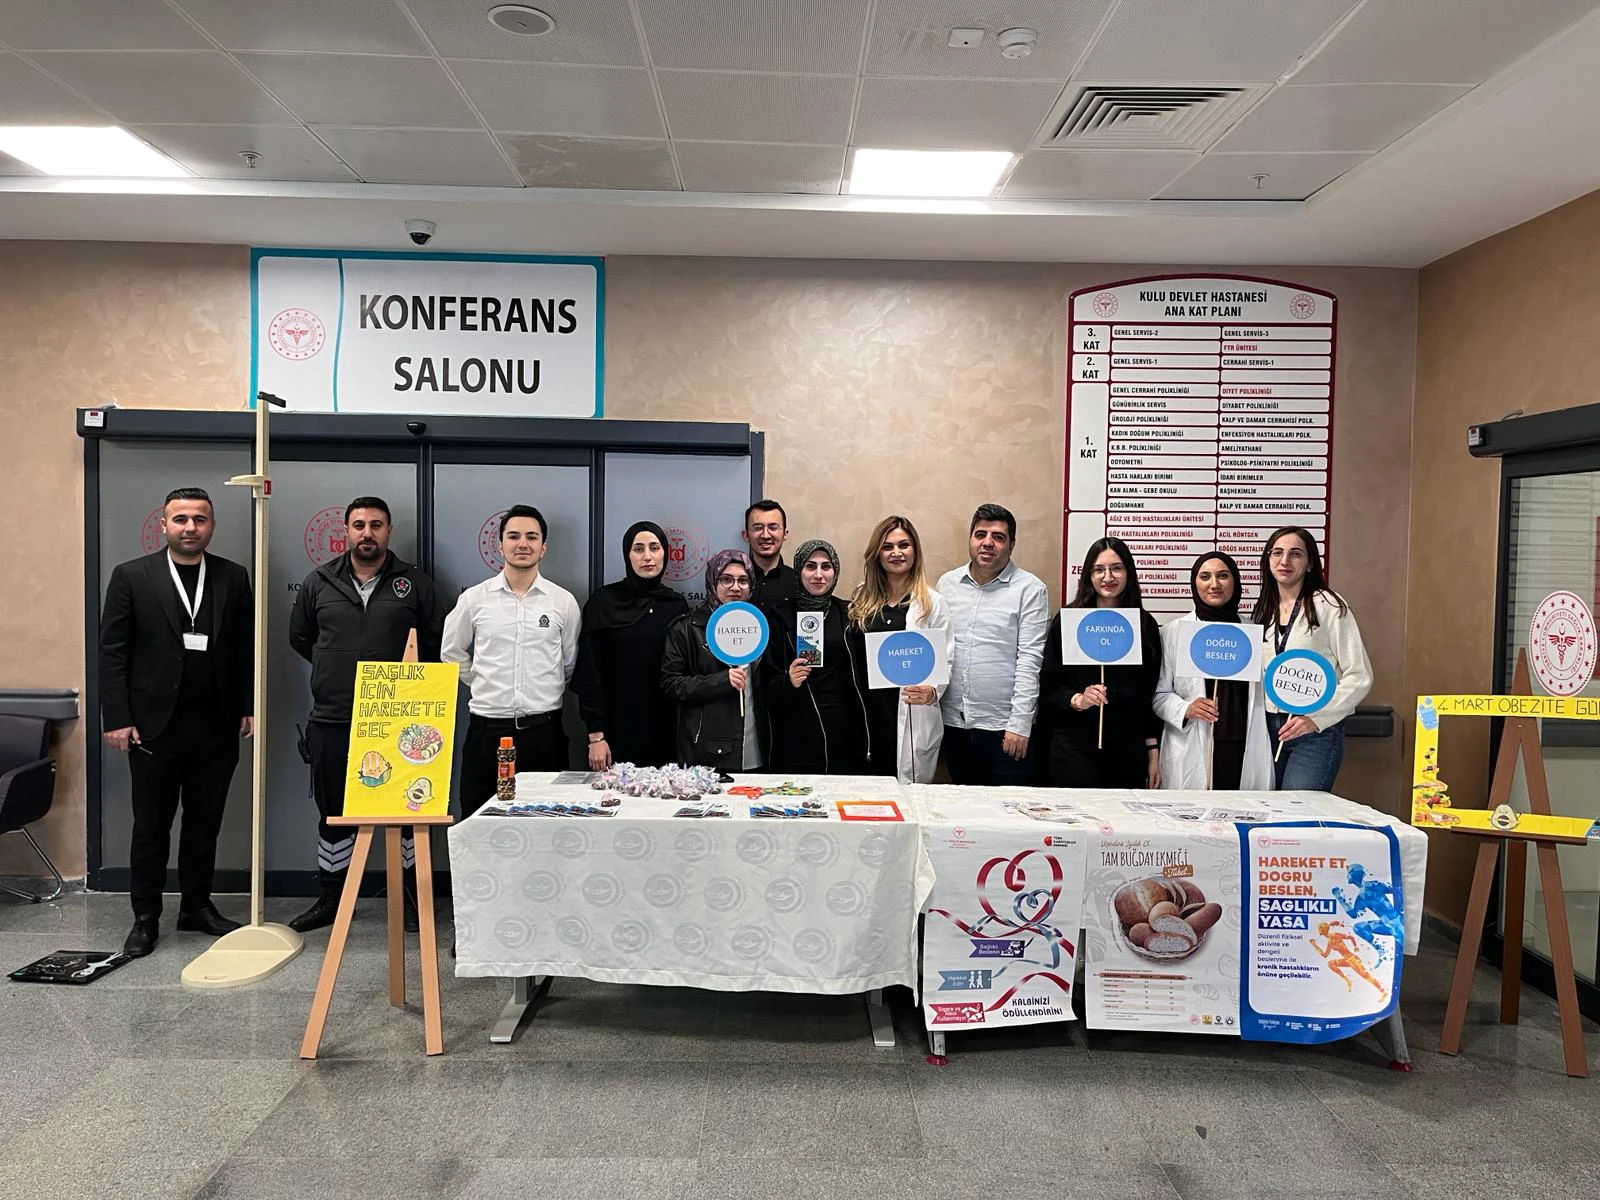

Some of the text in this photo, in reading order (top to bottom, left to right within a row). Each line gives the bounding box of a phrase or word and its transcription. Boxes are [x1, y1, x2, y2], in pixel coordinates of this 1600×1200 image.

[1140, 290, 1268, 303] KULU DEVLET HASTANESİ
[360, 294, 577, 334] KONFERANS
[1164, 306, 1242, 317] ANA KAT PLANI
[1087, 328, 1096, 337] 3.
[1132, 328, 1159, 336] SERVİS-2
[1083, 340, 1100, 350] KAT
[1236, 344, 1258, 352] ÜNİTESİ
[1086, 356, 1095, 366] 2.
[393, 356, 541, 395] SALONU
[1082, 370, 1100, 379] KAT
[1131, 386, 1156, 394] CERRAHİ
[1246, 402, 1279, 410] POLİKLİNİĞİ
[1267, 416, 1297, 424] CERRAHİSİ
[1151, 430, 1184, 438] POLİKLİNİĞİ
[1221, 430, 1255, 438] ENFEKSİYON
[1084, 436, 1094, 446] 1.
[1128, 444, 1161, 452] POLİKLİNİĞİ
[1080, 449, 1098, 458] KAT
[1110, 458, 1143, 466] ODYOMETRİ
[1220, 488, 1257, 496] BAŞHEKİMLİK
[1264, 502, 1295, 510] CERRAHİSİ
[1160, 530, 1194, 538] POLİKLİNİĞİ
[717, 626, 759, 635] HAREKET
[1085, 625, 1125, 634] FARKINDA
[732, 637, 744, 646] ET
[1100, 638, 1112, 646] OL
[1206, 638, 1238, 648] DOĞRU
[888, 648, 924, 657] HAREKET
[1205, 651, 1236, 661] BESLEN
[902, 660, 912, 668] ET
[1278, 664, 1324, 684] DOĞRU
[1274, 678, 1322, 698] BESLEN
[358, 701, 446, 718] HAREKETE
[1437, 697, 1600, 716] 4 MART OBEZİTE GÜ
[357, 722, 392, 738] GEÇ
[1101, 848, 1188, 866] TAM BUĞDAY EKMEĞİ
[1258, 856, 1350, 870] HAREKET ET,
[1258, 884, 1317, 897] BESLEN,
[1012, 996, 1050, 1006] KALBİNİZİ
